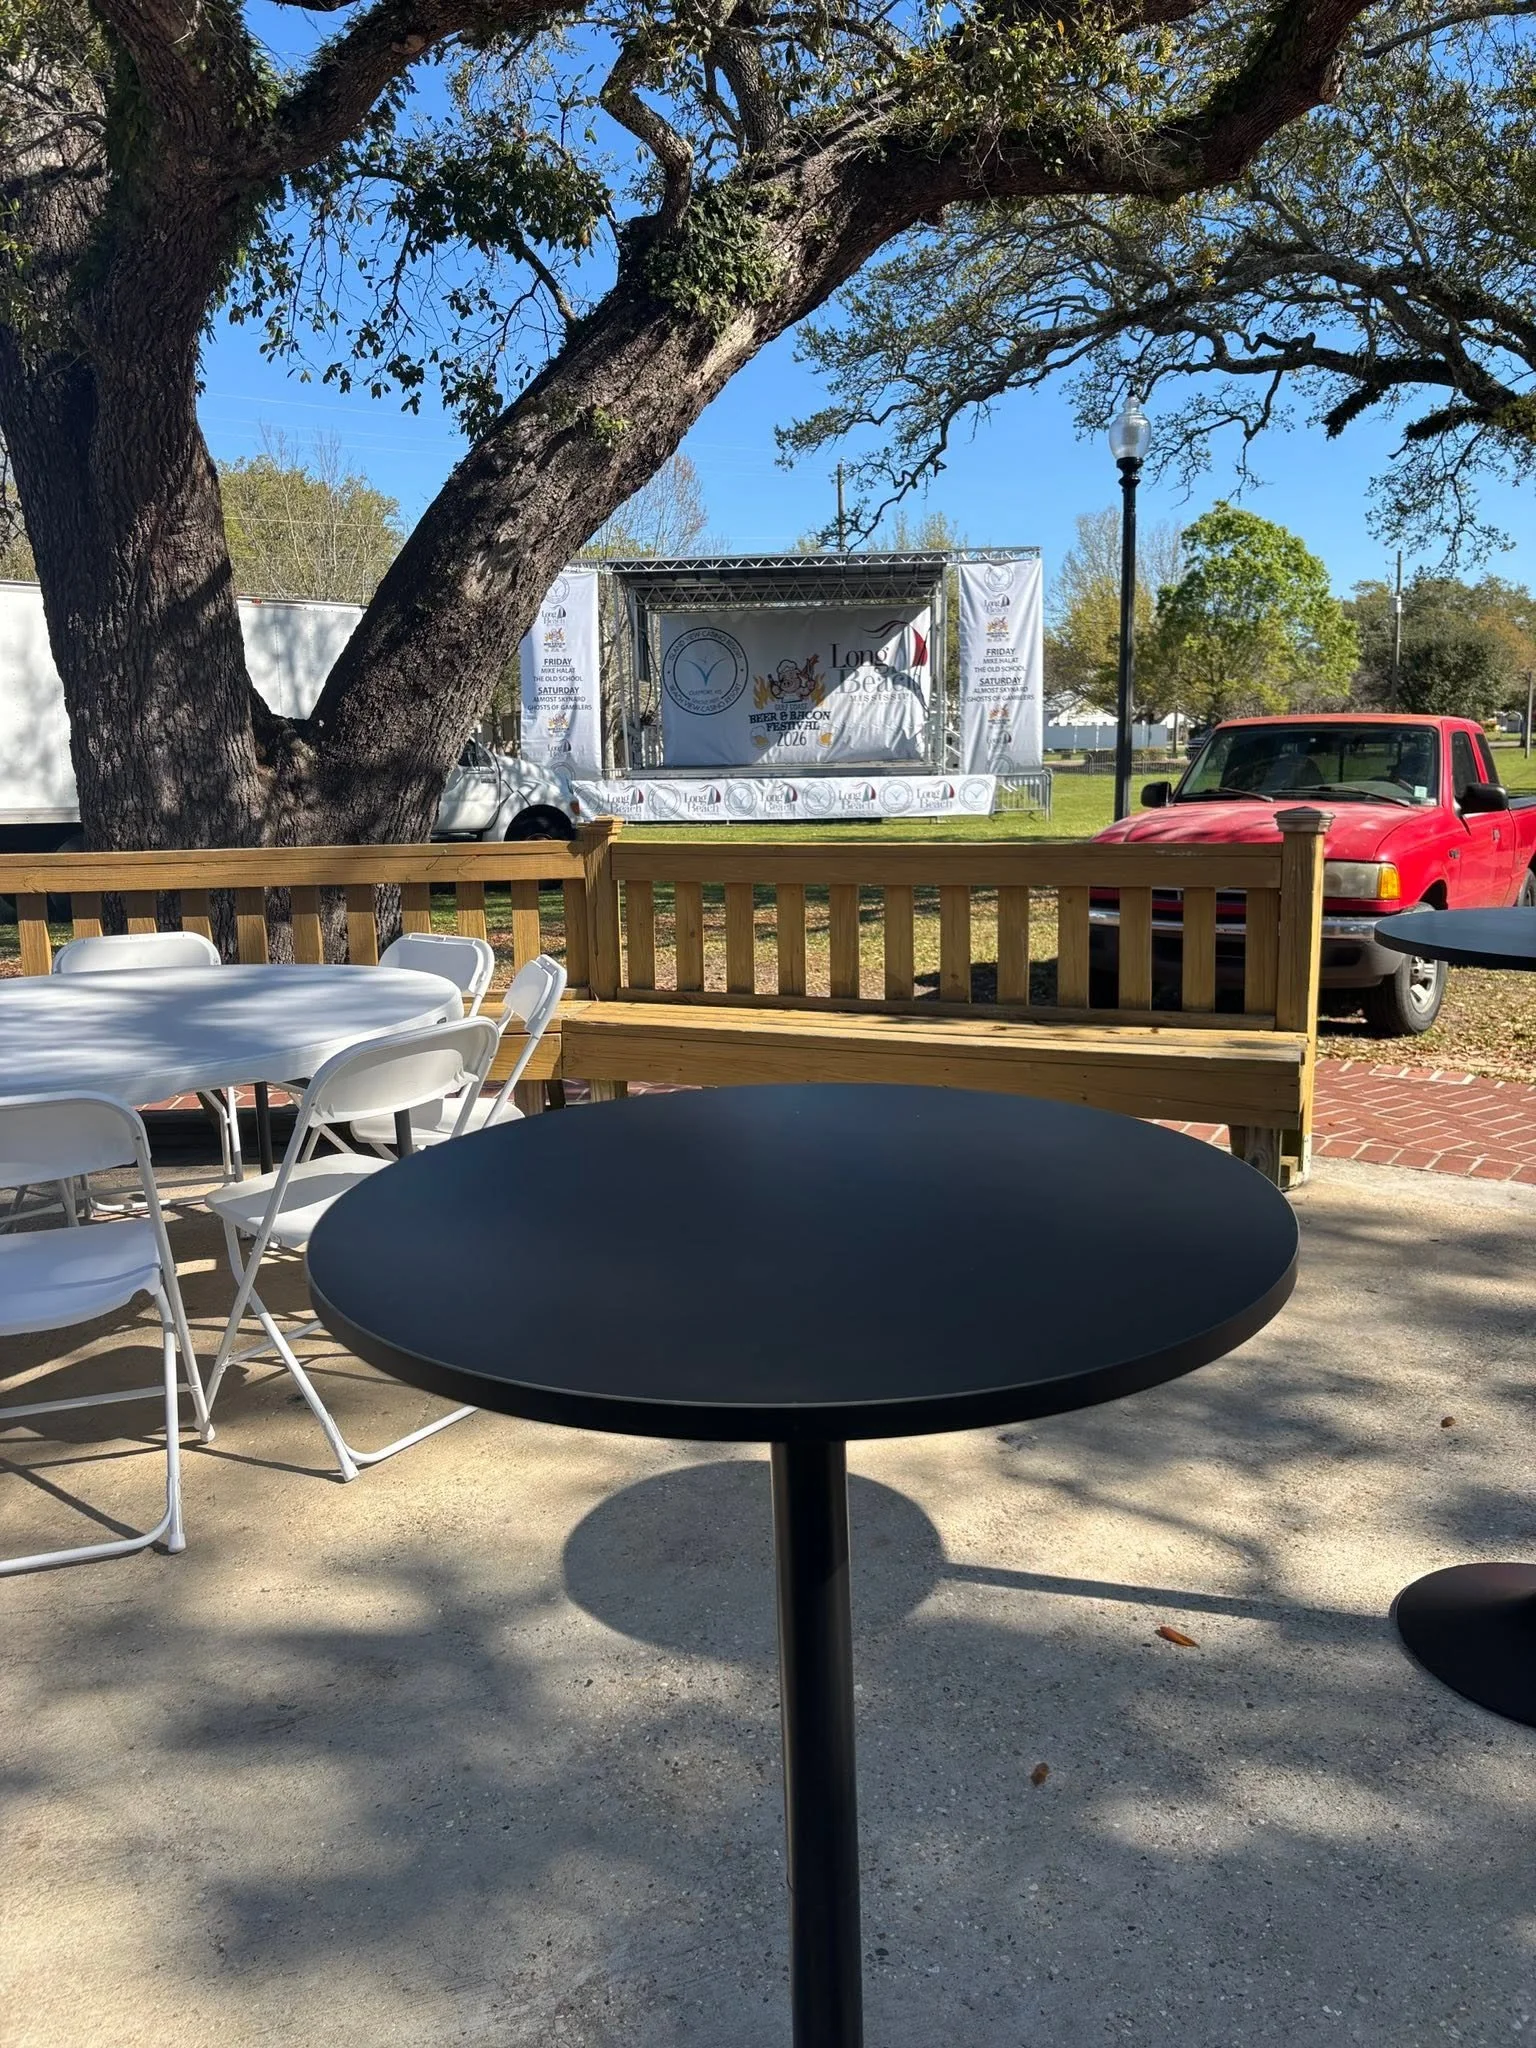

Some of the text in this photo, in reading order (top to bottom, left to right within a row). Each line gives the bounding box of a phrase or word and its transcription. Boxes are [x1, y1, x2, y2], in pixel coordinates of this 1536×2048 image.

[685, 631, 701, 640] VIEW
[701, 630, 727, 642] CASINO
[726, 640, 742, 660] RESORT
[543, 658, 572, 666] FRIDAY
[828, 643, 889, 675] Long
[835, 668, 918, 694] Beach
[980, 677, 1023, 686] SATURDAY
[538, 686, 580, 694] SATURDAY
[684, 701, 701, 711] VIEW
[701, 702, 725, 712] CASINO
[724, 683, 742, 703] RESORT
[774, 702, 808, 711] GULF COAST
[749, 710, 831, 724] BEER & BACON
[766, 721, 820, 731] FESTIVAL
[776, 731, 807, 746] 2026
[607, 793, 630, 804] Long
[684, 792, 707, 803] Long
[761, 791, 783, 802] Long
[838, 790, 861, 801] Long
[917, 789, 940, 799] Long
[611, 802, 642, 813] Beach
[688, 801, 719, 812] Beach
[764, 801, 796, 812] Beach
[842, 800, 874, 810] Beach
[921, 798, 953, 808] Beach
